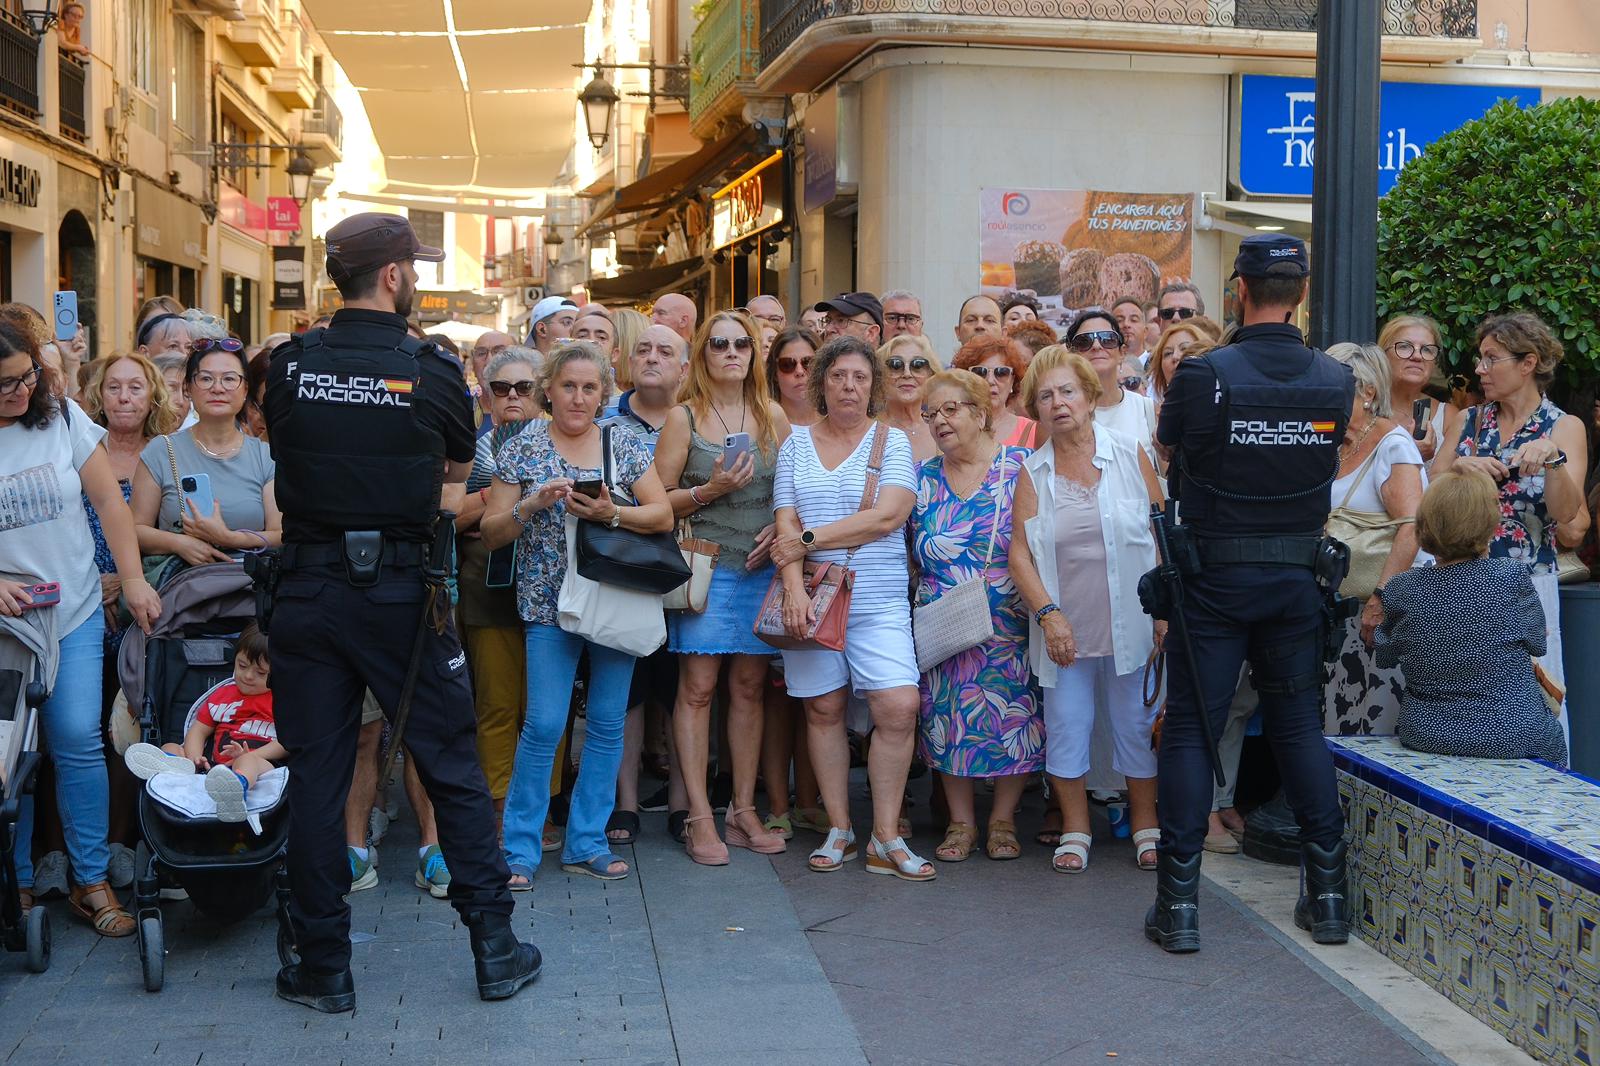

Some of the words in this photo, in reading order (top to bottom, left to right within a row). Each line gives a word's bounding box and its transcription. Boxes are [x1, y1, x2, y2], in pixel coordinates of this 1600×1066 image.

[1088, 218, 1109, 230] TUS
[299, 386, 410, 406] NACIONAL
[1230, 433, 1333, 445] NACIONAL
